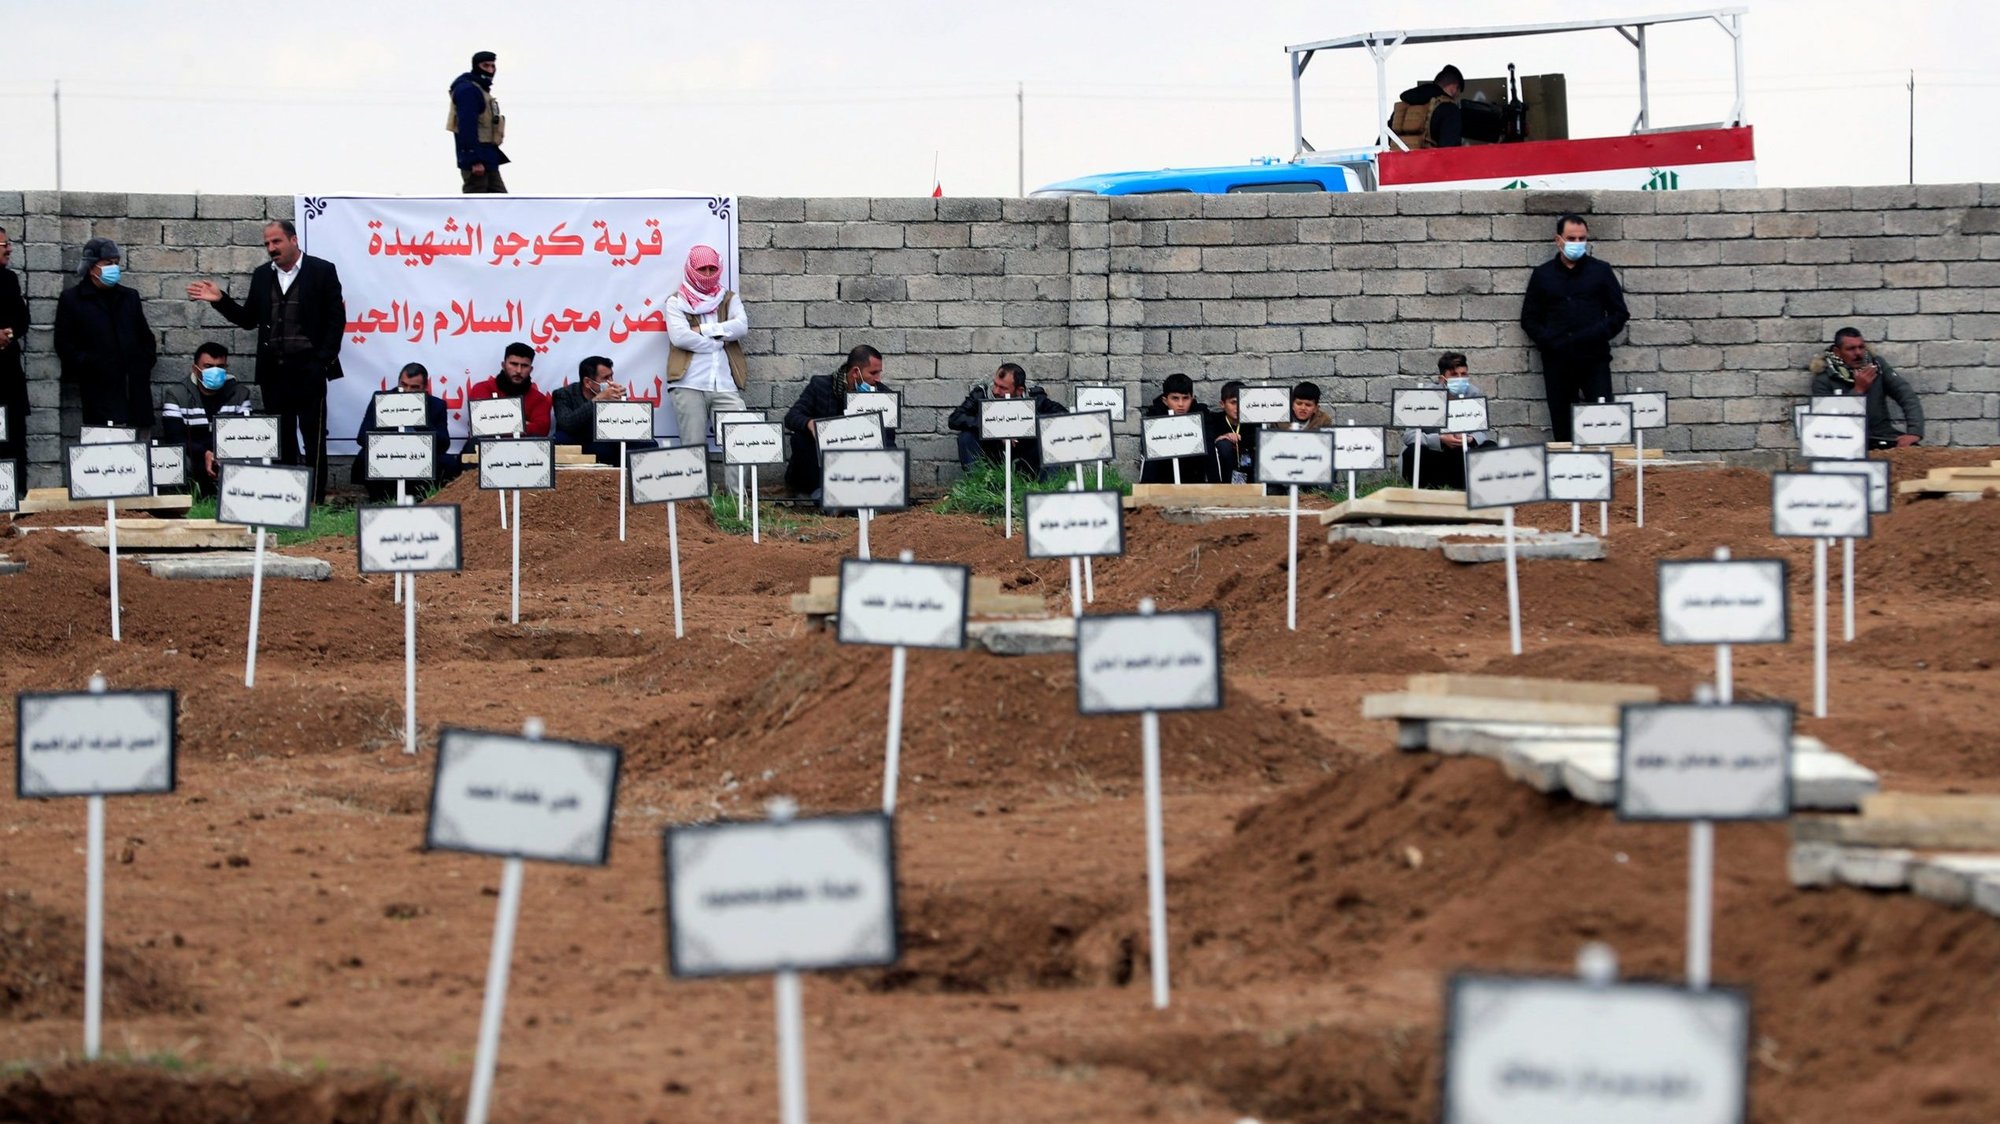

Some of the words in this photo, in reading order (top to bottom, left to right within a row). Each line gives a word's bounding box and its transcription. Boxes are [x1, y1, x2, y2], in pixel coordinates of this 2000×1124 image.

[368, 216, 482, 266] الشهيدة
[487, 221, 584, 266] كوجو
[593, 218, 663, 266] قرية
[342, 299, 424, 343] والحي
[433, 299, 524, 344] السلام
[531, 307, 601, 353] محبي
